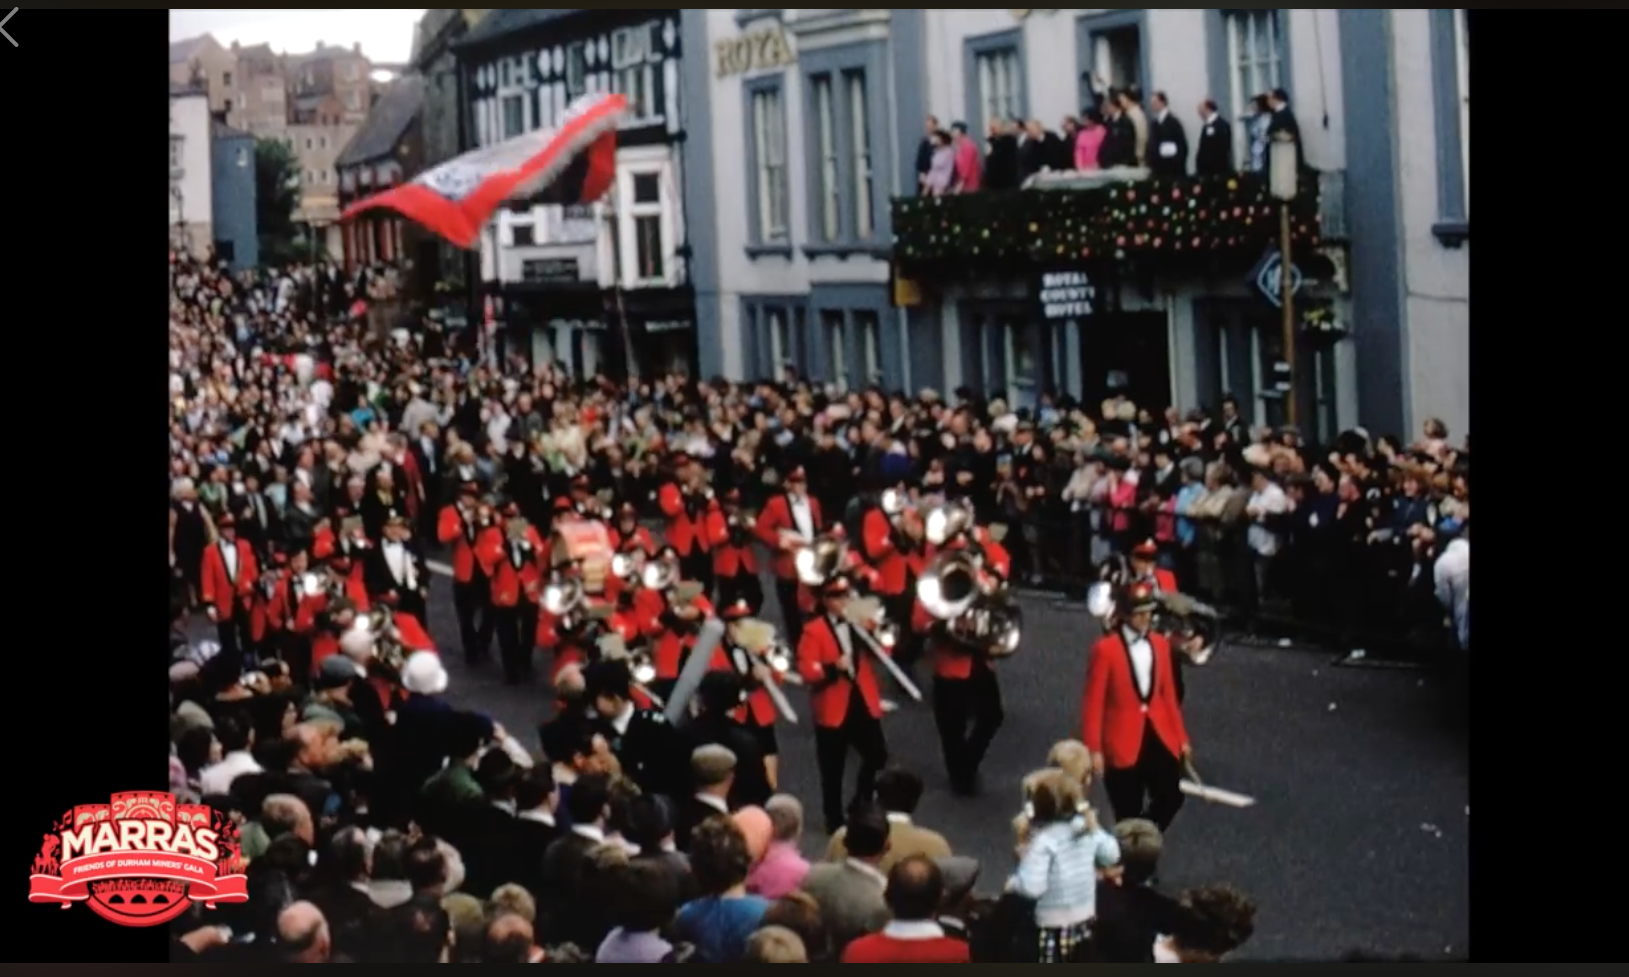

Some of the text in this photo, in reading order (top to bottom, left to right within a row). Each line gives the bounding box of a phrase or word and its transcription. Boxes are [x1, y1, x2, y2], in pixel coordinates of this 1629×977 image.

[1042, 271, 1089, 288] ROYAL
[1039, 286, 1096, 303] COUNTY
[1044, 301, 1094, 319] HOTEL
